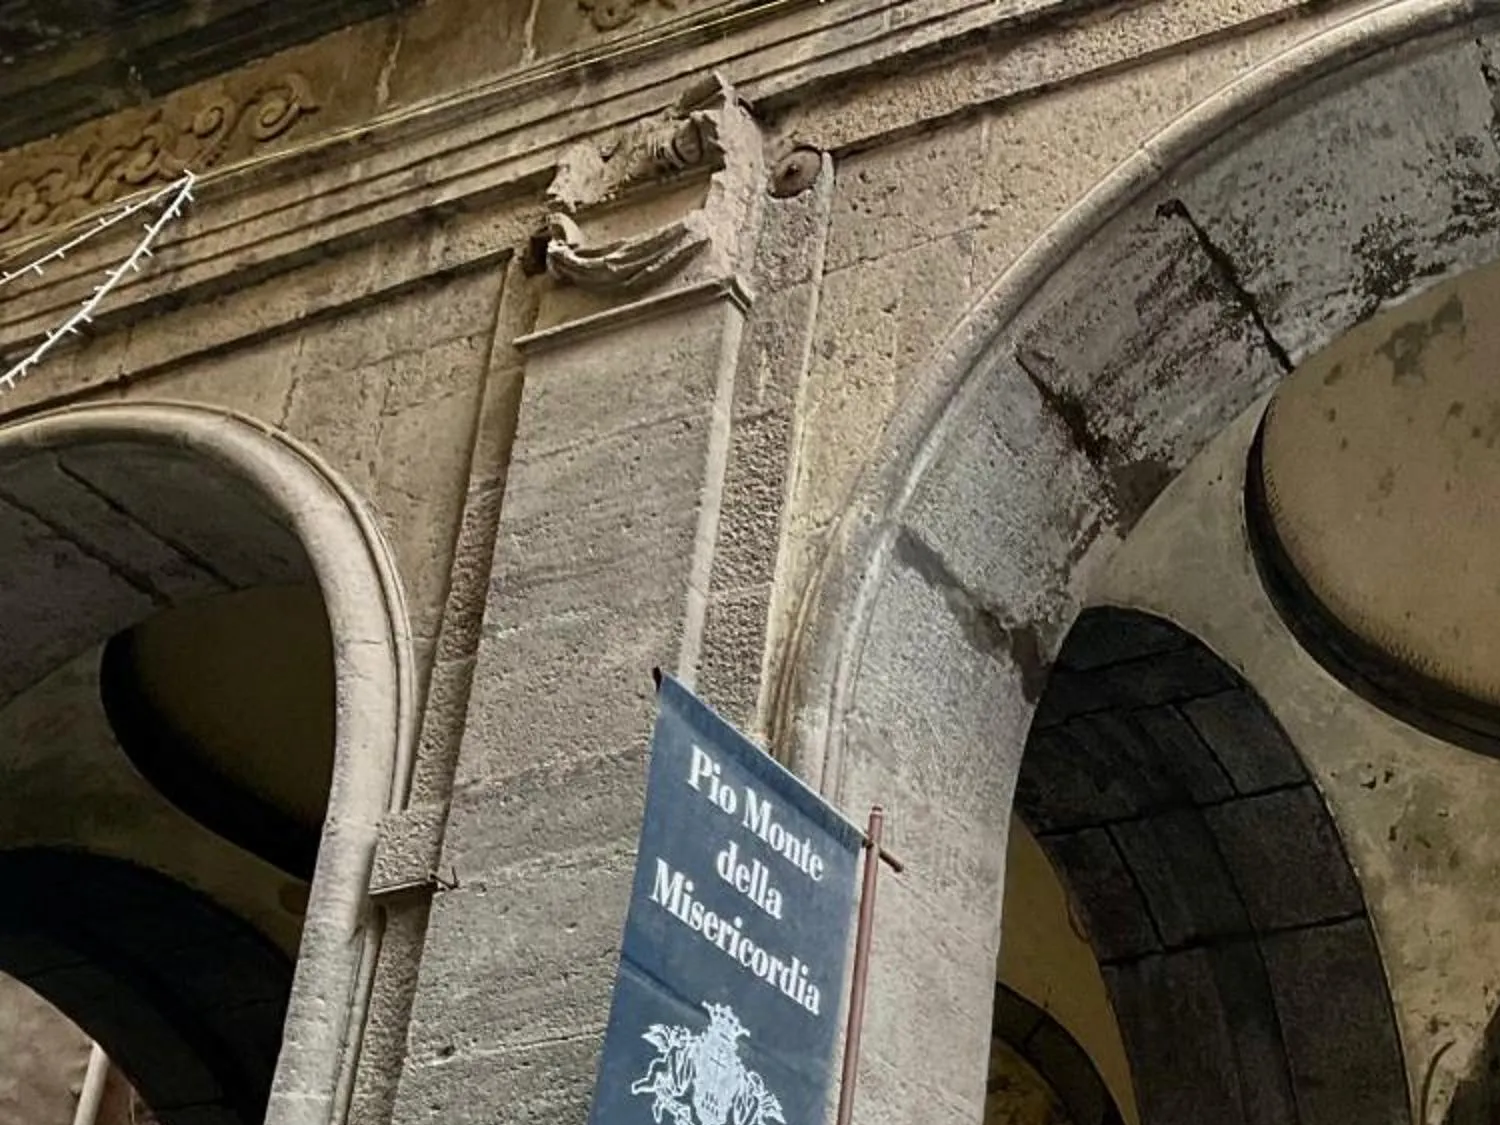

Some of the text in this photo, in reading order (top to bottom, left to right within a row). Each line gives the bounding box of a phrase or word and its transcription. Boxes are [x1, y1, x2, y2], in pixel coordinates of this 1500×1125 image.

[686, 744, 826, 883] Pio Monte
[716, 840, 783, 920] della
[648, 857, 822, 1017] Misericordia
